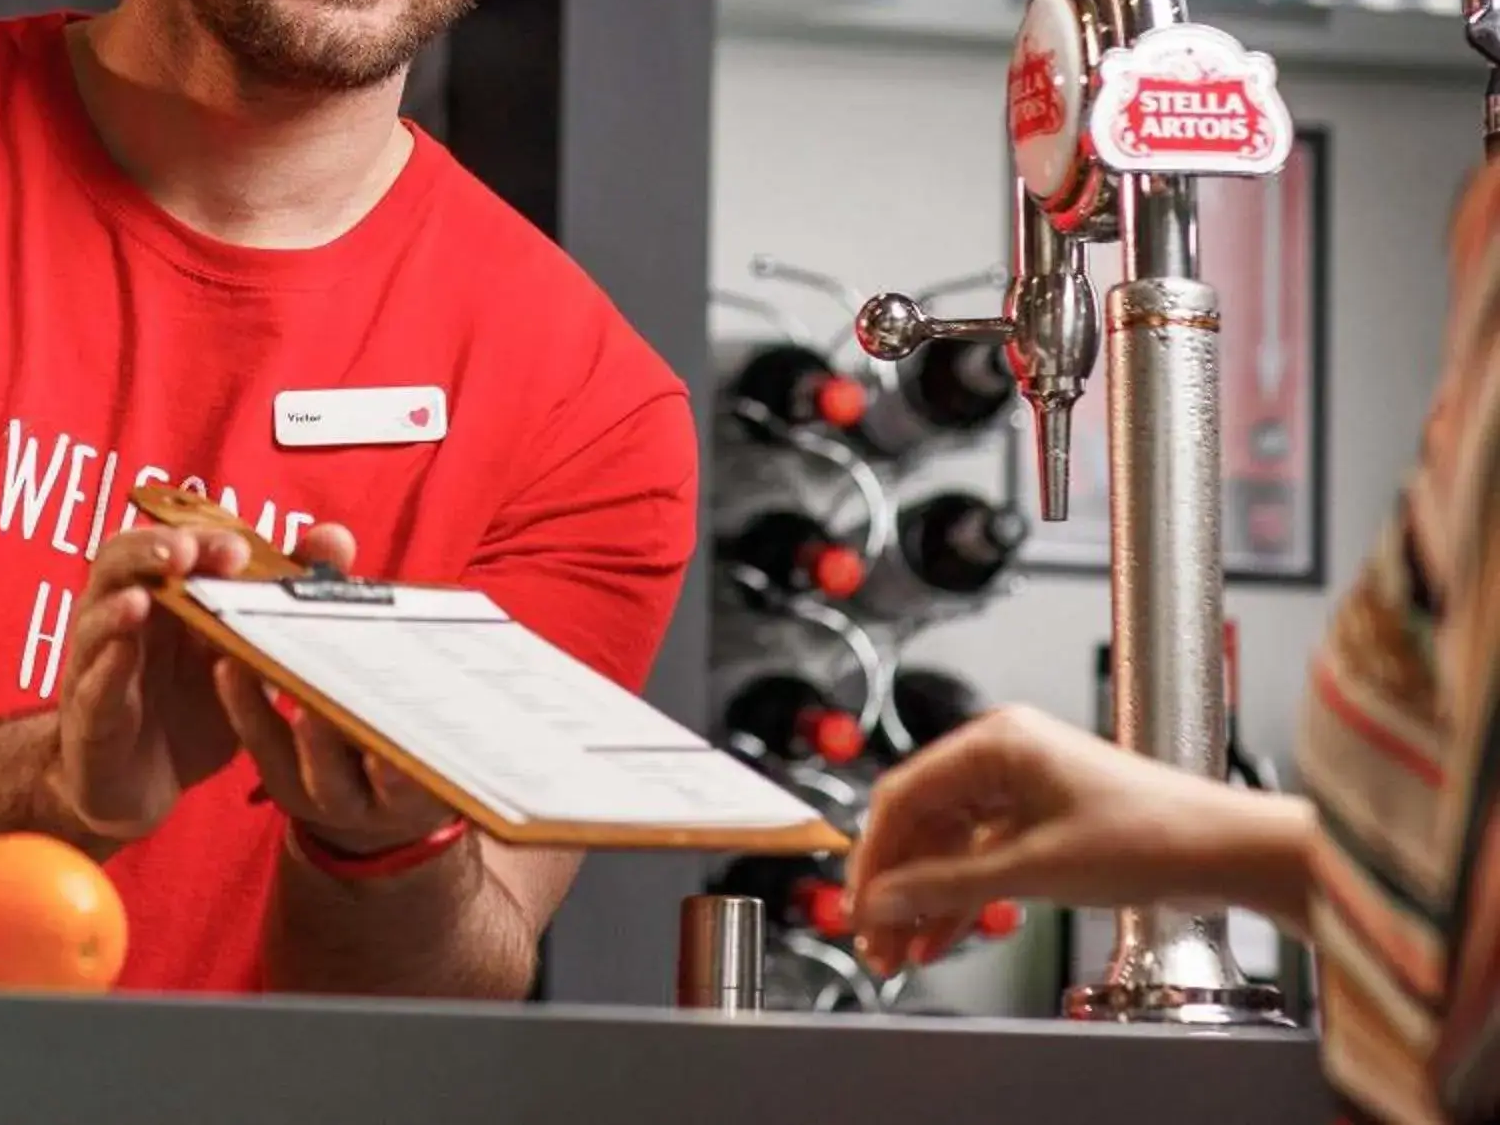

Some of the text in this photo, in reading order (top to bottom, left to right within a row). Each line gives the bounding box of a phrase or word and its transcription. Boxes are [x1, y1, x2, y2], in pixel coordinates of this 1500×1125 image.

[1139, 90, 1246, 114] STELLA
[1141, 115, 1250, 140] ARTOIS
[287, 412, 321, 423] Victor
